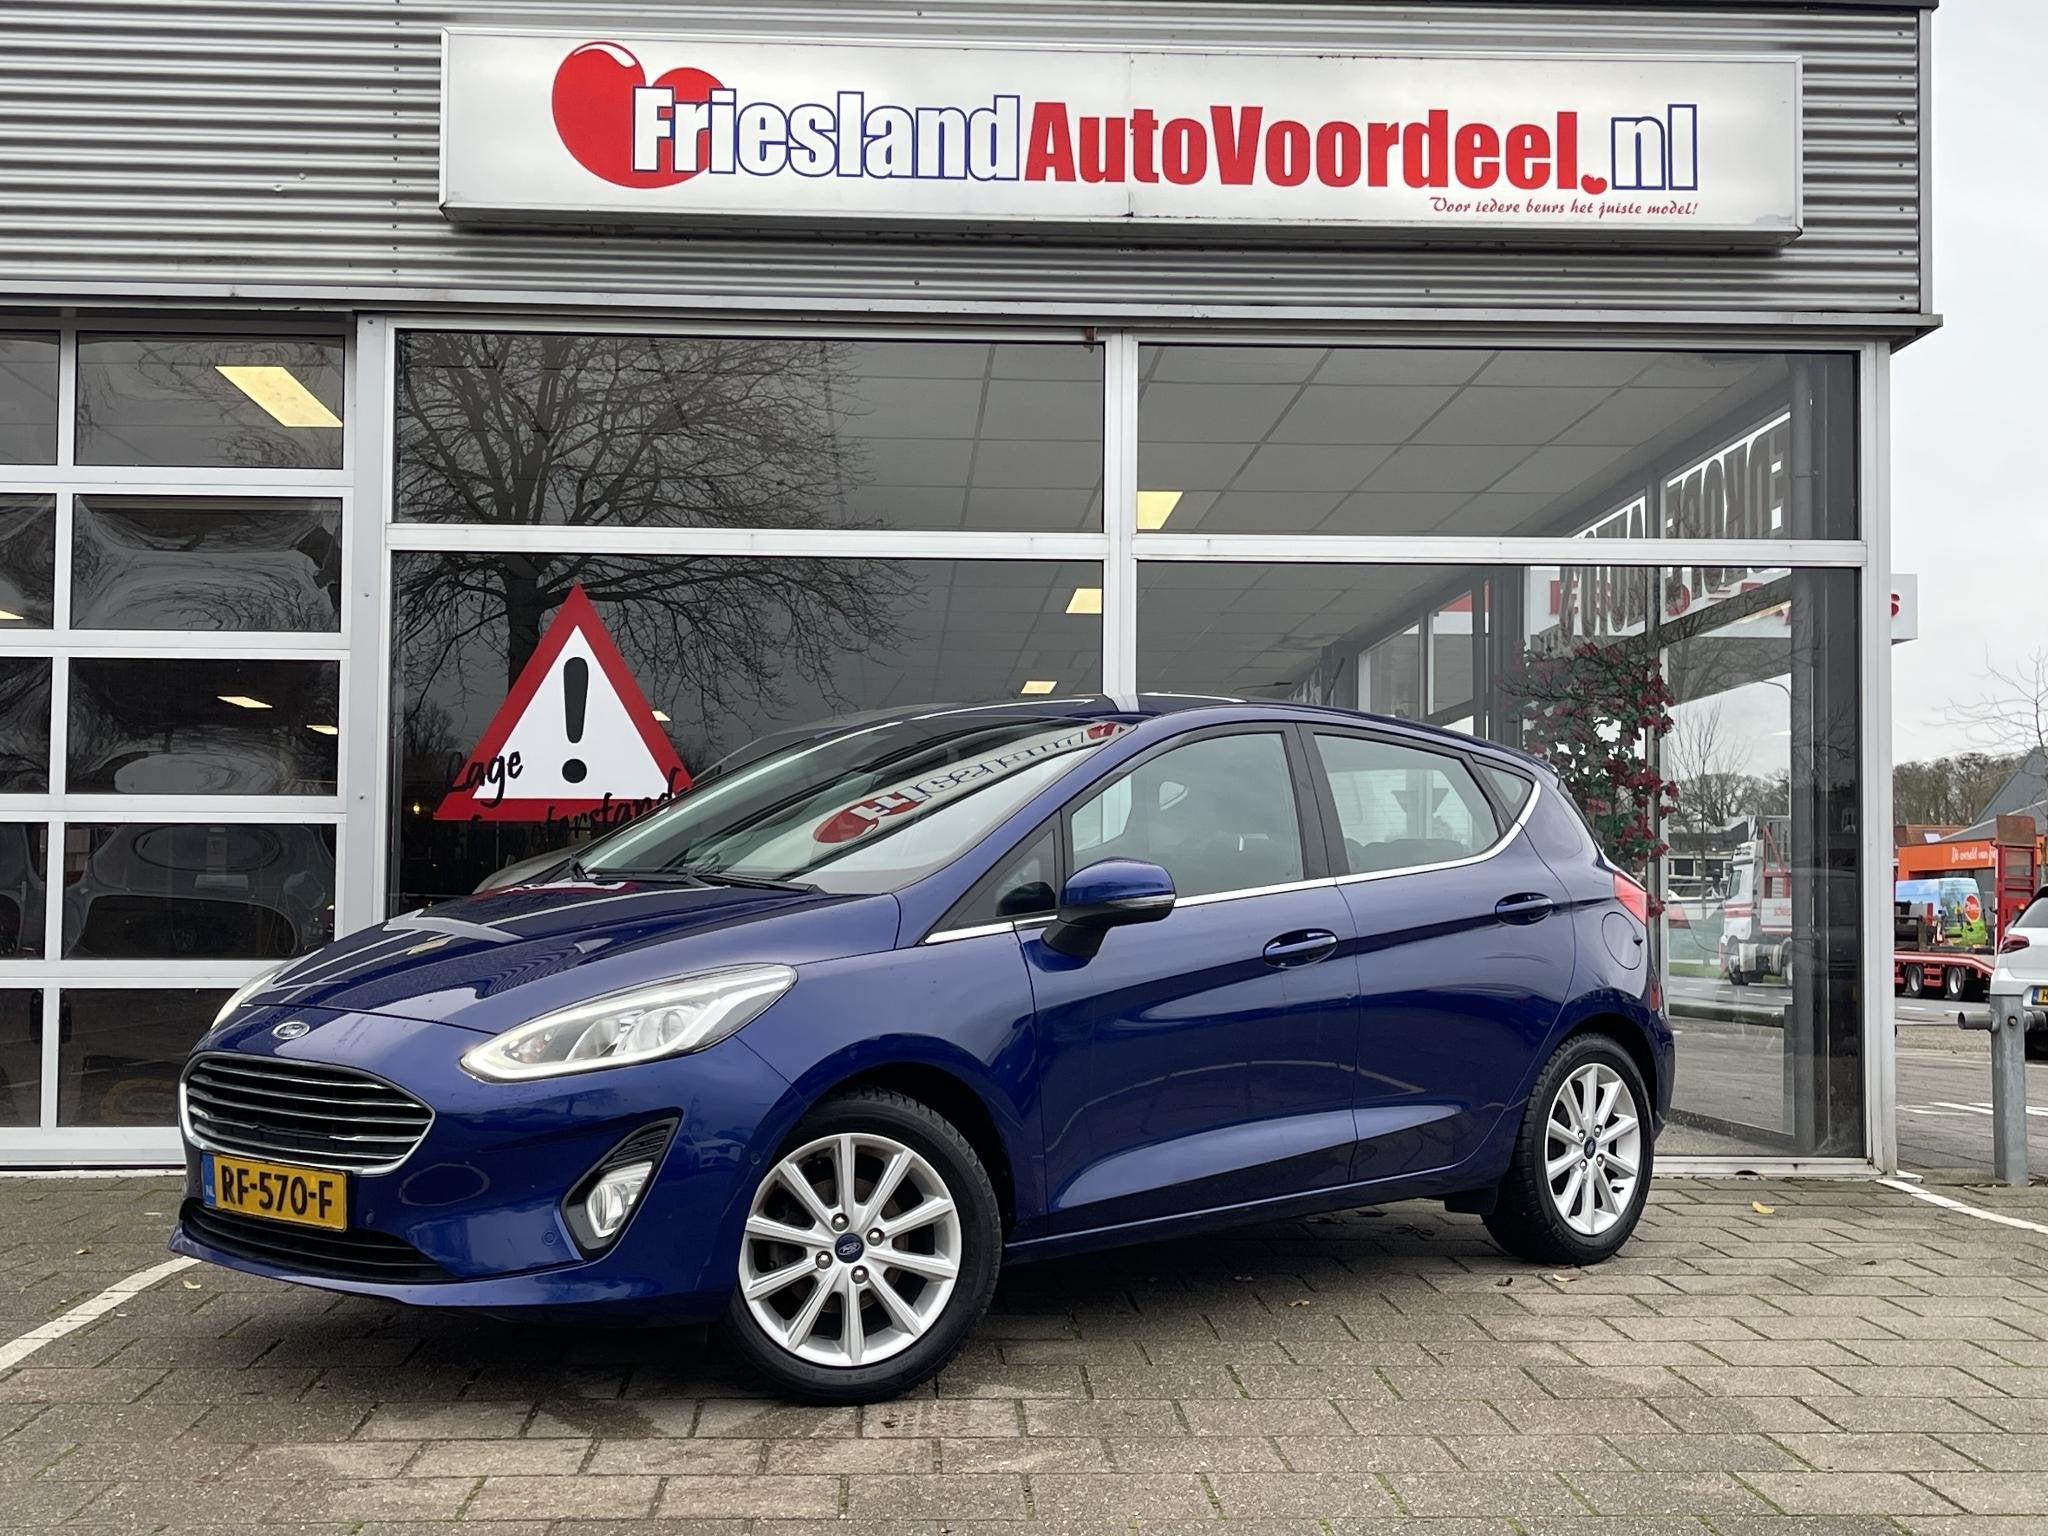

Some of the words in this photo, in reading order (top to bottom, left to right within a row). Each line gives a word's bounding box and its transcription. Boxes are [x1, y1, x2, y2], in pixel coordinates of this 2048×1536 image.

[631, 86, 1698, 195] FrieslandAutoVoordeel.nl
[1429, 196, 1471, 213] Voor
[1526, 198, 1565, 214] beurs
[1570, 197, 1593, 214] het
[1598, 201, 1642, 219] juiste
[1647, 200, 1698, 215] model!
[449, 749, 524, 808] Lage
[221, 1165, 333, 1219] RF-570-F
